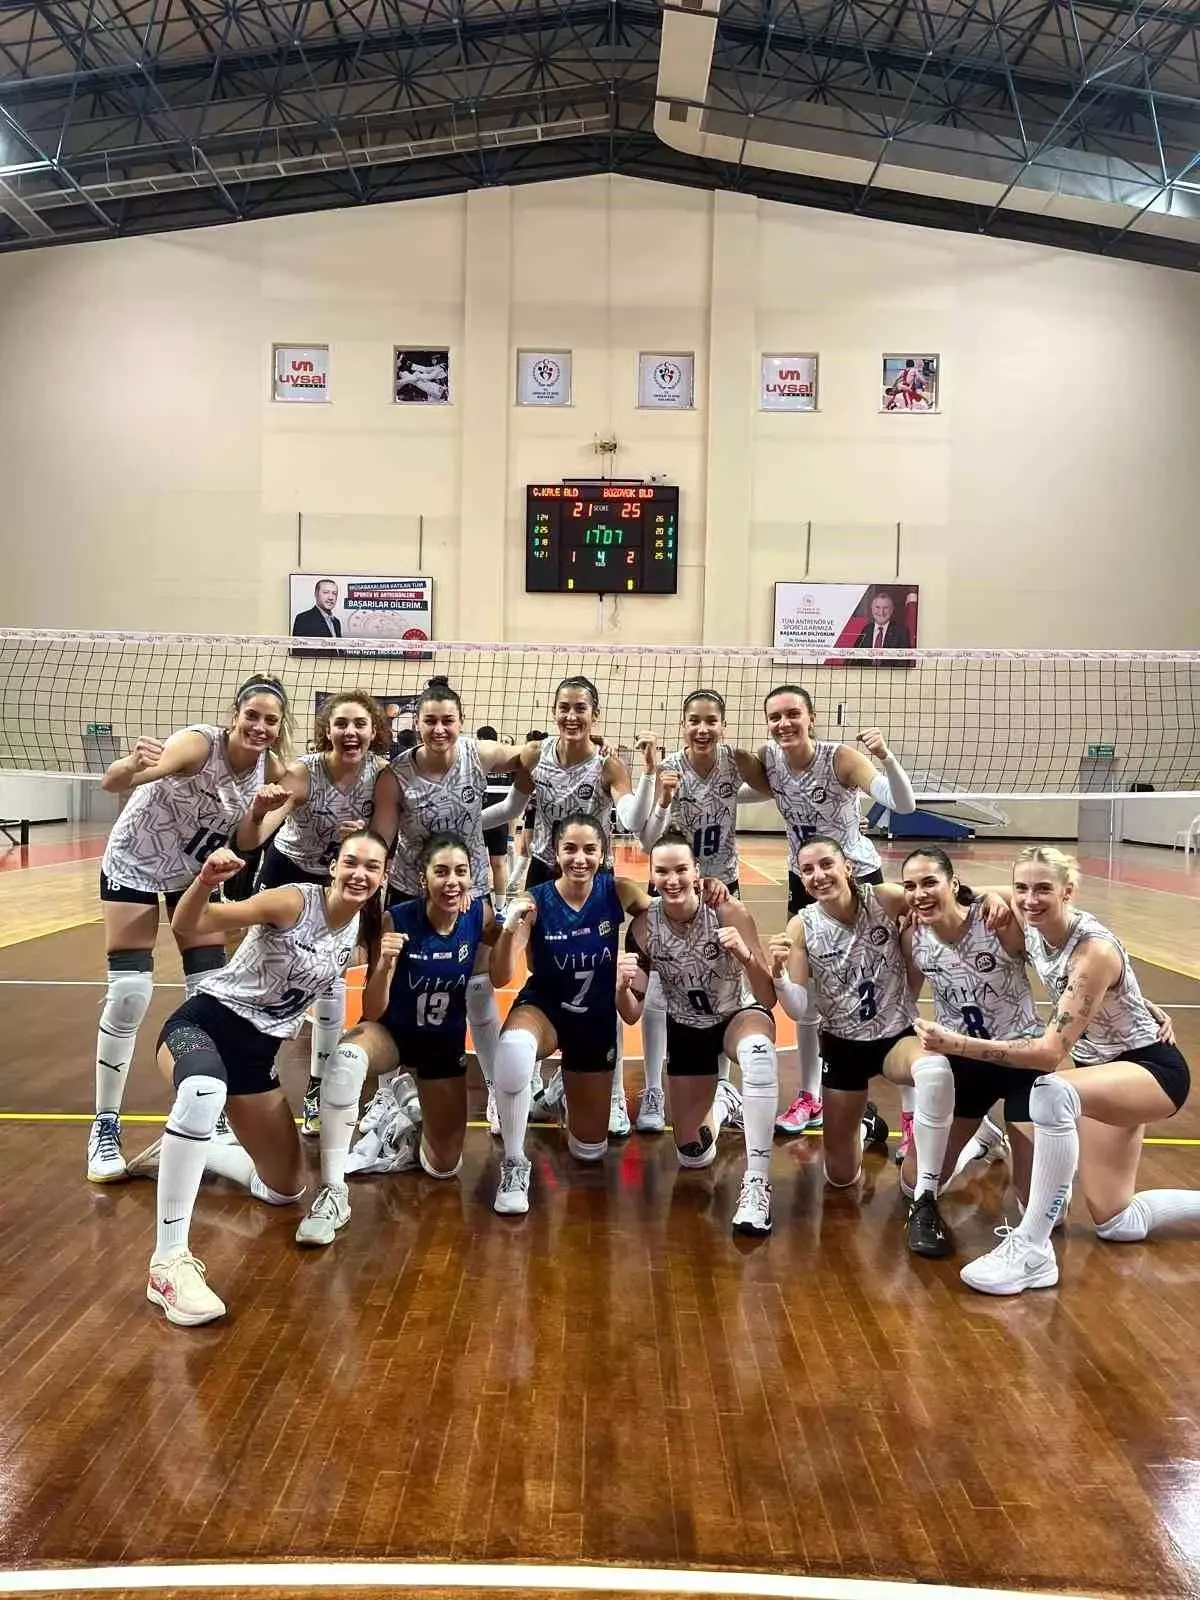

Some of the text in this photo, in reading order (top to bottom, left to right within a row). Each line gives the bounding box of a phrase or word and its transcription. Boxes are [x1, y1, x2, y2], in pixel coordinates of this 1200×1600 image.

[573, 502, 593, 517] 21
[621, 503, 641, 518] 25
[571, 551, 576, 563] 1
[597, 551, 606, 563] 4
[626, 551, 635, 564] 2
[348, 600, 423, 609] BAŞARILAR DİLERİM.
[693, 825, 721, 857] 19
[553, 946, 612, 971] VitrA
[408, 971, 466, 990] VitrA
[561, 971, 595, 1014] 7
[858, 981, 877, 1022] 3
[940, 982, 999, 1004] VitrA
[417, 992, 450, 1027] 13
